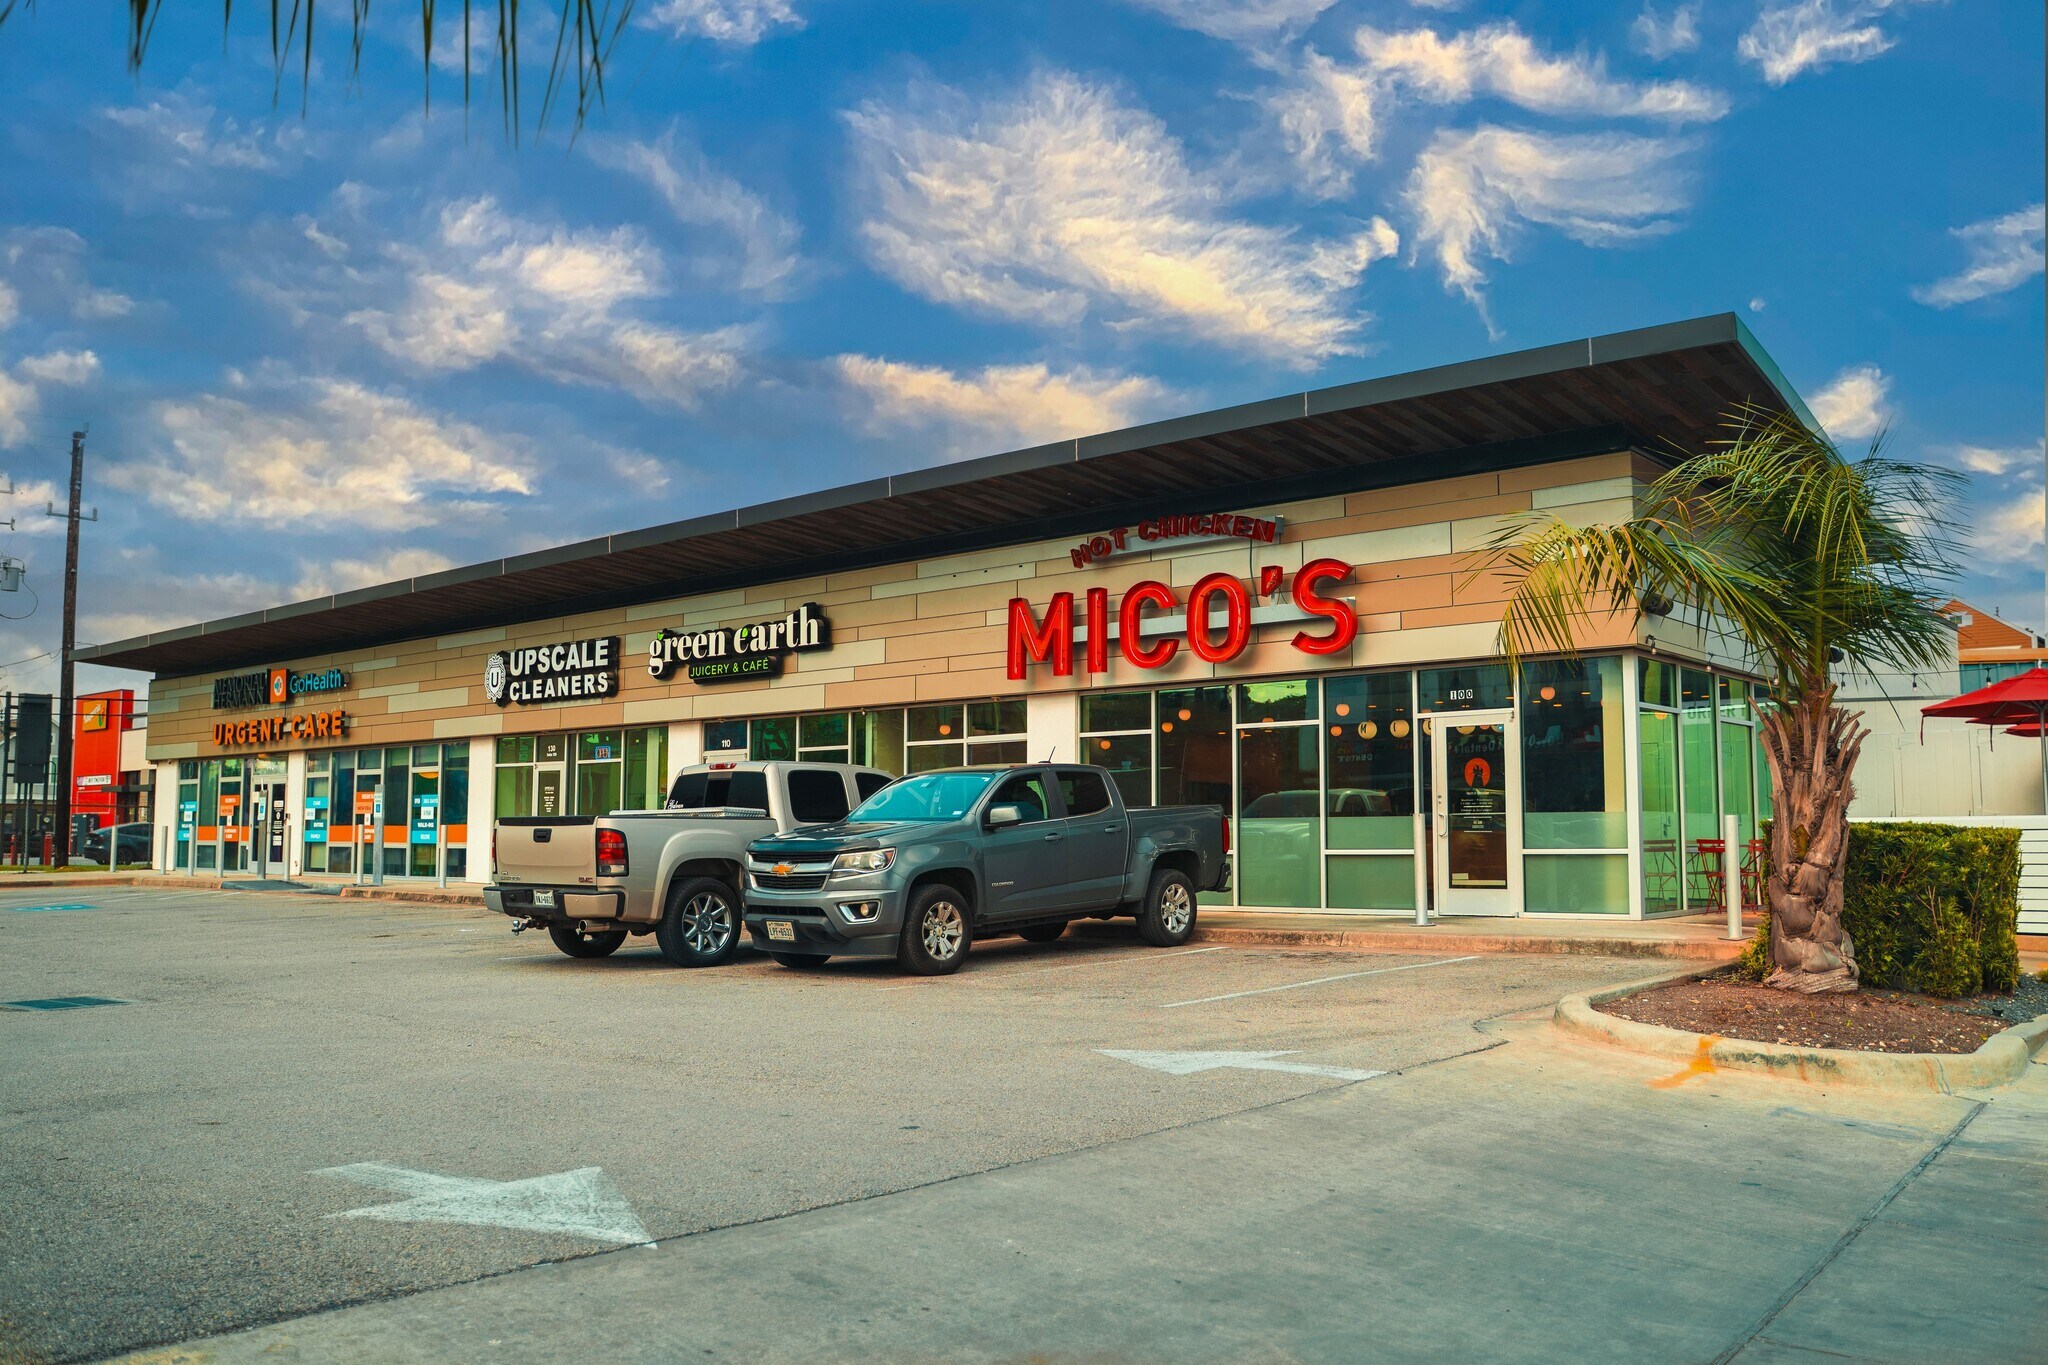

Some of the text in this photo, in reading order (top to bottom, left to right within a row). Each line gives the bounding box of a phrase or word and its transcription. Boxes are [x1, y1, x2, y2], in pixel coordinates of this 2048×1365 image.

[1070, 513, 1276, 569] HOT CHICKEN
[1007, 558, 1359, 681] MICO'S
[648, 606, 820, 676] green earth
[509, 639, 609, 677] UPSCALE
[690, 657, 769, 677] JUICERY & CAFÉ
[215, 673, 264, 694] MEMORIAL
[290, 669, 341, 694] GoHealth
[491, 672, 499, 688] U
[509, 672, 608, 701] CLEANERS
[213, 686, 264, 709] HERMANN
[1450, 689, 1473, 700] 100
[213, 710, 343, 746] URGENT CARE
[721, 739, 731, 748] 110
